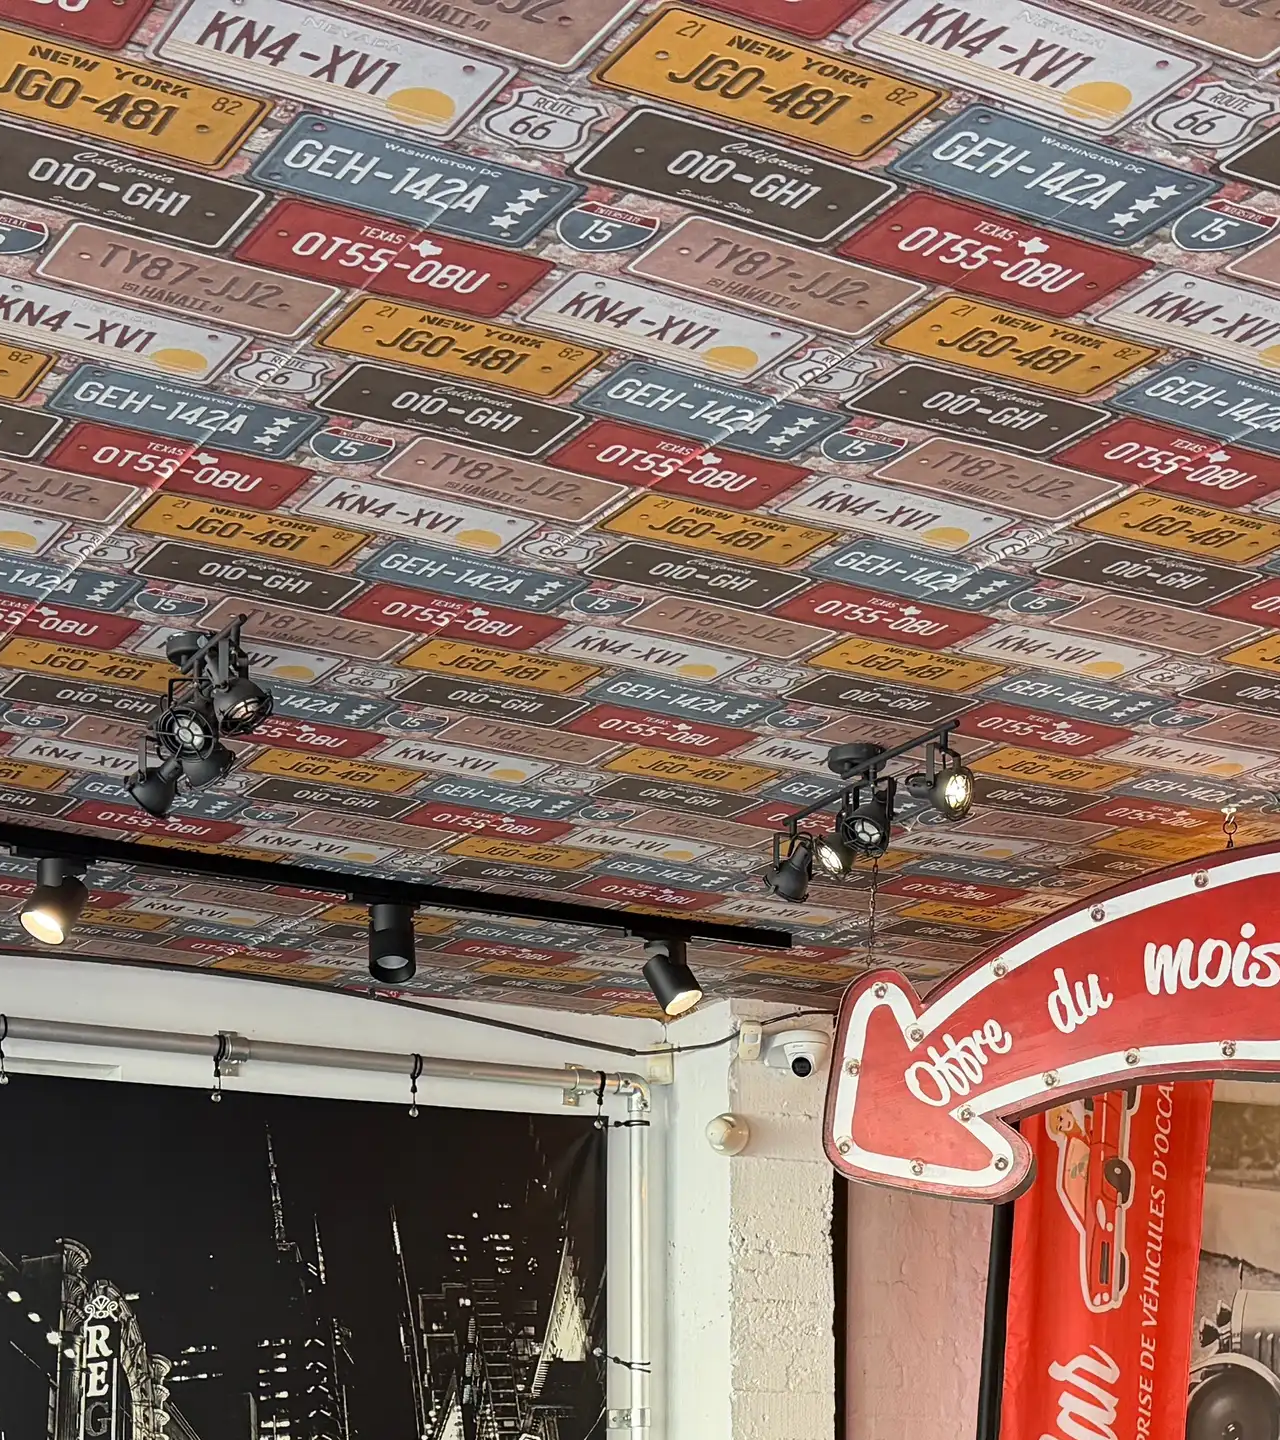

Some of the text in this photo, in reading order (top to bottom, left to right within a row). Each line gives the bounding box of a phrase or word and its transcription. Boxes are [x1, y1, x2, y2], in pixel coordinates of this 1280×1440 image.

[674, 17, 711, 36] 21
[28, 43, 194, 97] NEW YORK
[725, 33, 877, 88] NEW YORK
[208, 97, 244, 115] 82
[529, 96, 583, 116] ROUTE
[882, 88, 922, 106] 82
[1205, 91, 1259, 111] ROUTE
[503, 117, 561, 140] 66
[1166, 113, 1230, 136] 66
[70, 148, 178, 182] California
[717, 141, 818, 174] California
[927, 132, 1130, 209] GEH-142A
[280, 138, 490, 214] GEH-142A
[356, 224, 408, 243] TEXAS
[572, 218, 627, 243] 15
[970, 221, 1022, 240] TEXAS
[1184, 217, 1246, 242] 15
[71, 381, 248, 434] GEH-142A
[1047, 967, 1115, 1034] du
[1152, 1081, 1176, 1181] D'OCCA
[1140, 1185, 1167, 1327] VÉHICULES
[1140, 1333, 1157, 1371] DE
